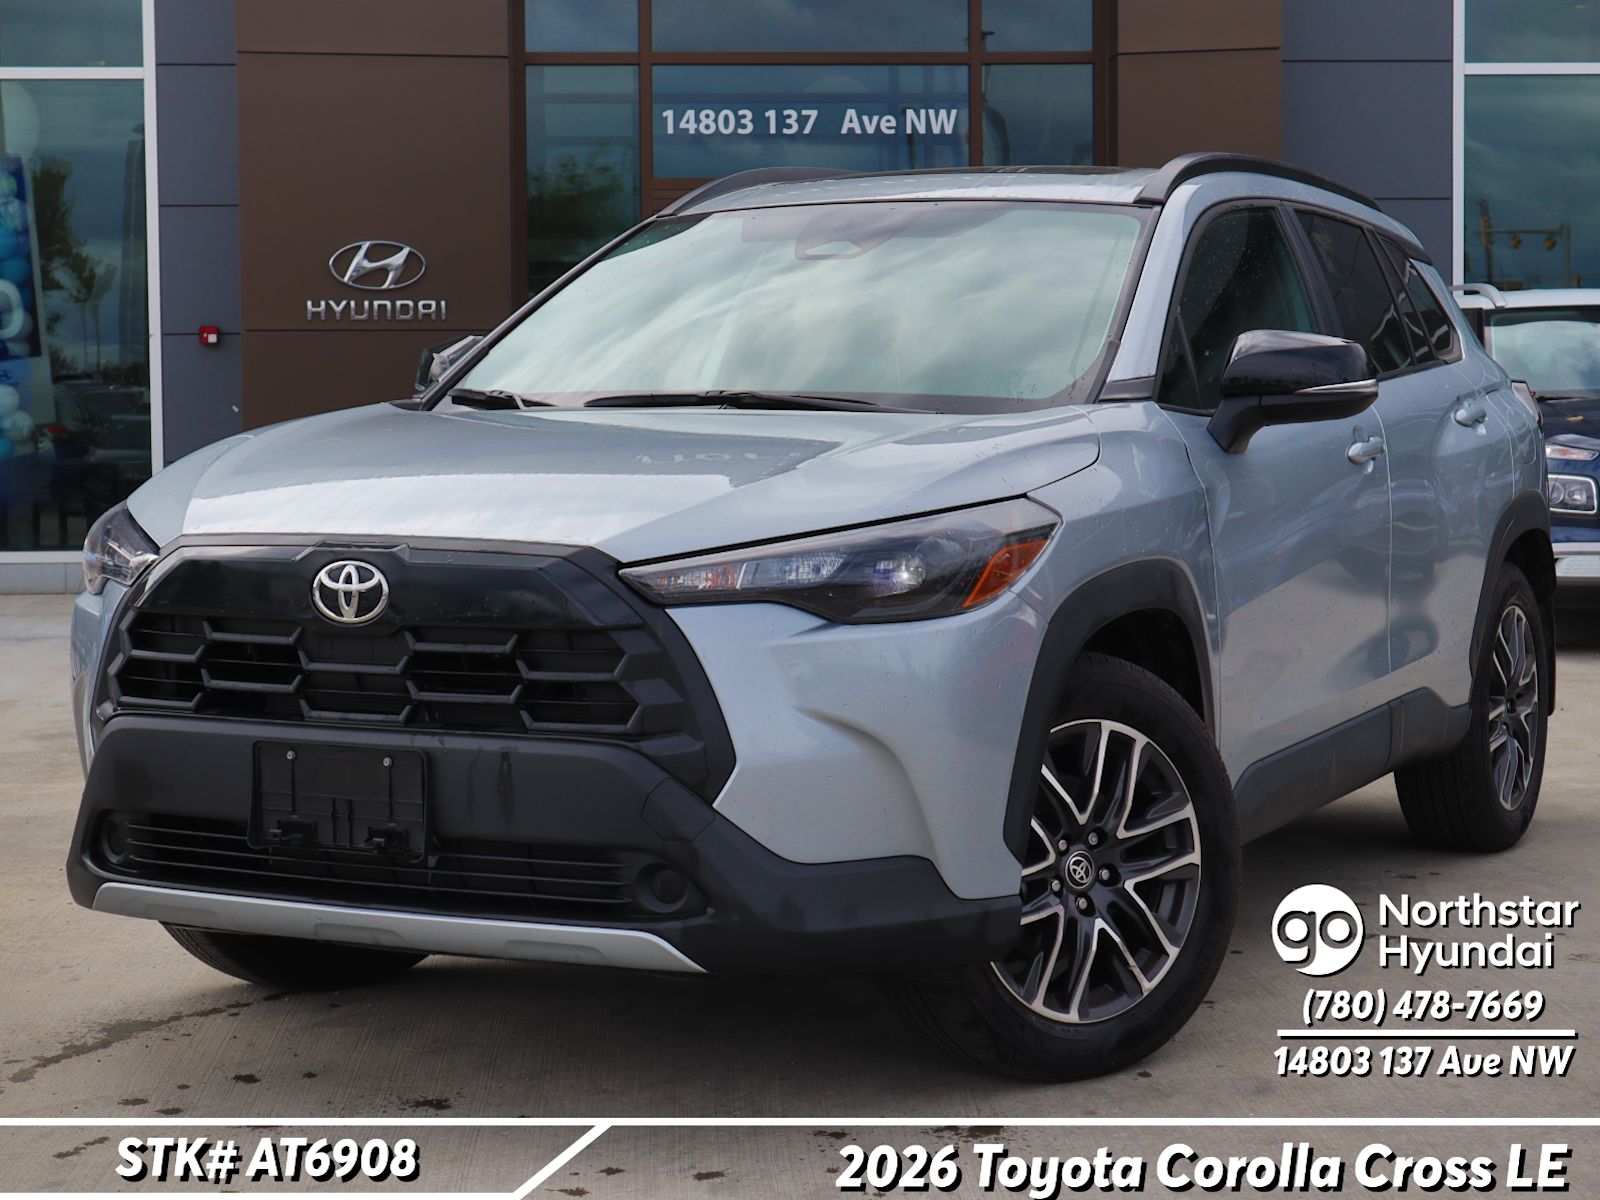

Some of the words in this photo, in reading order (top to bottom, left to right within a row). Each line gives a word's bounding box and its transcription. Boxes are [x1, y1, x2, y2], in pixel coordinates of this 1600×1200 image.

[661, 109, 754, 135] 14803
[764, 109, 818, 135] 137
[840, 108, 897, 136] Ave
[905, 108, 957, 135] NW
[306, 299, 447, 320] HYUNDAI
